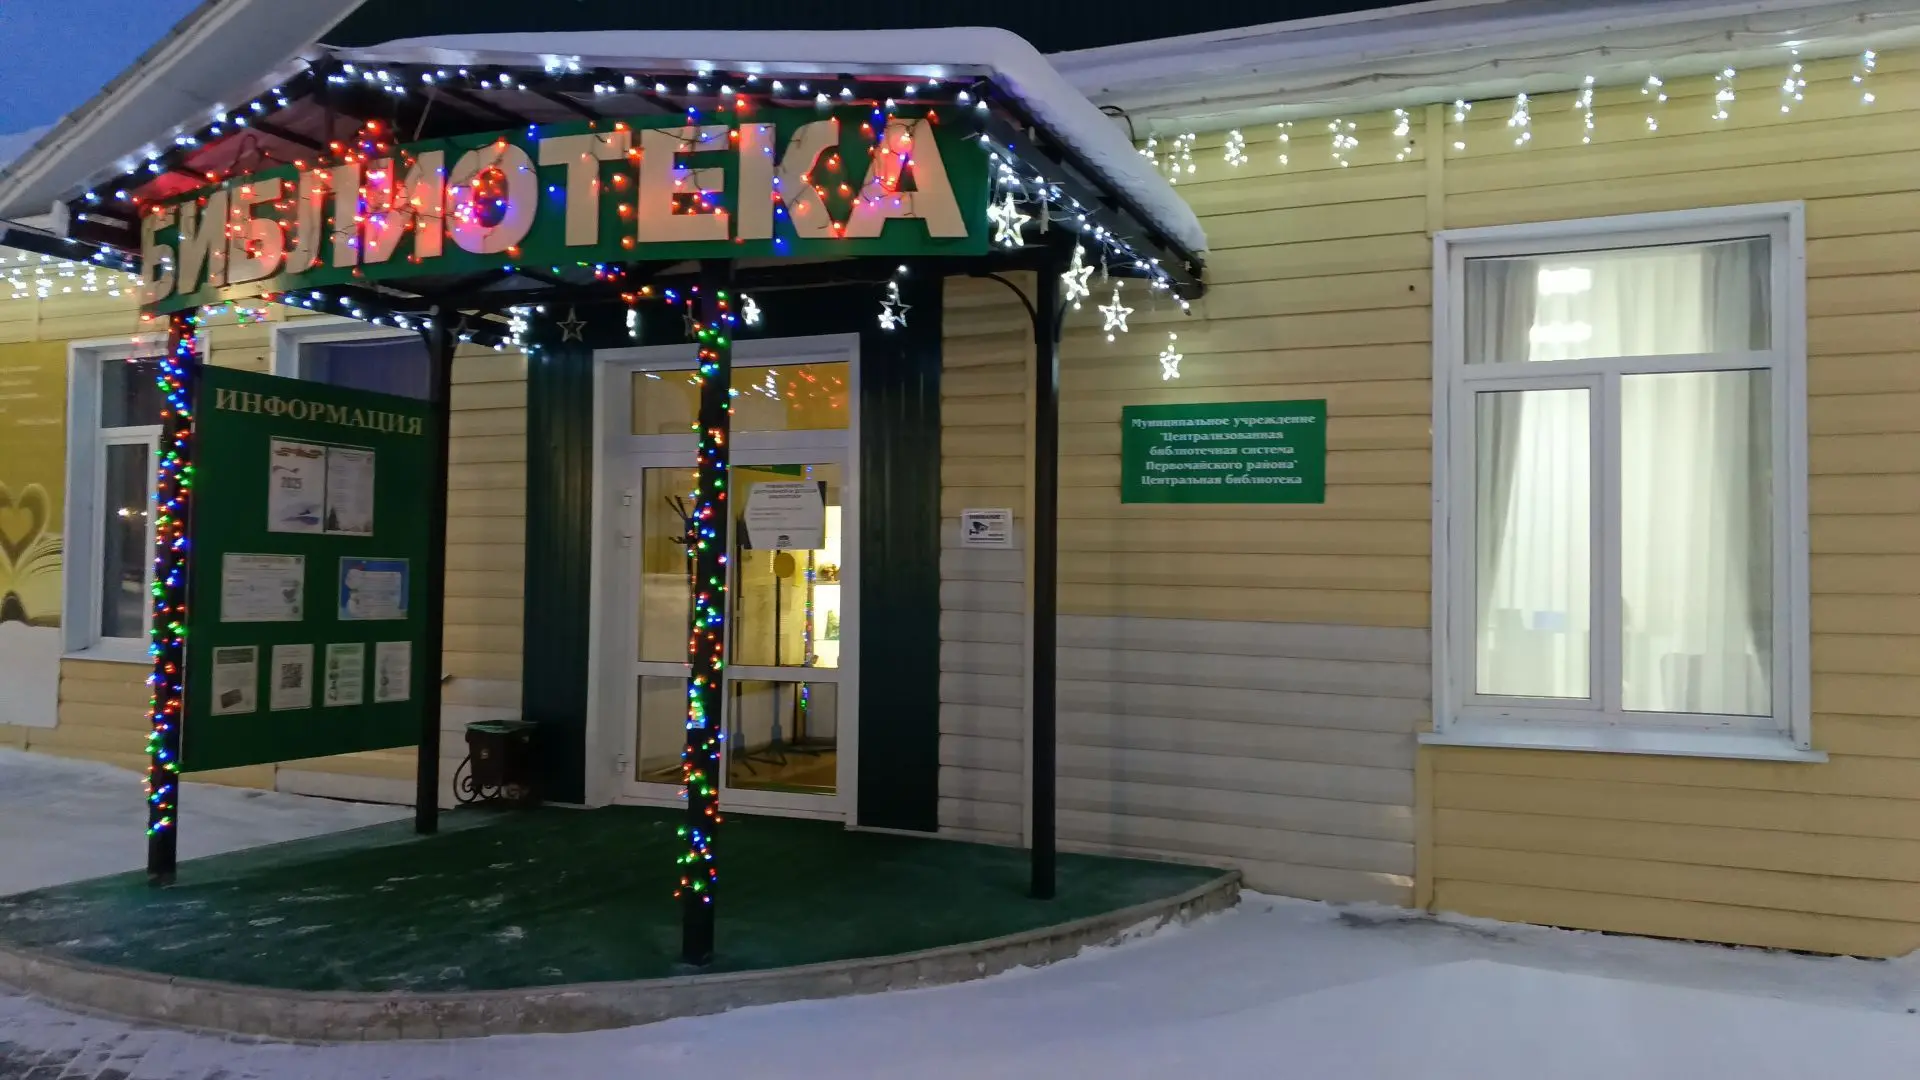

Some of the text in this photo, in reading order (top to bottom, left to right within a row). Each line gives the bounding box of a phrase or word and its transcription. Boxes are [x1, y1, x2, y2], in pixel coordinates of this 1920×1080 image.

[140, 115, 969, 305] БИБЛИОТЕКА
[215, 387, 425, 436] ИНФОРМАЦИЯ
[1131, 415, 1317, 429] Муниципальное учреждение
[1149, 445, 1294, 456] библиотечная система
[1145, 460, 1243, 473] Первомайского
[1141, 474, 1303, 487] Центральная библиотека
